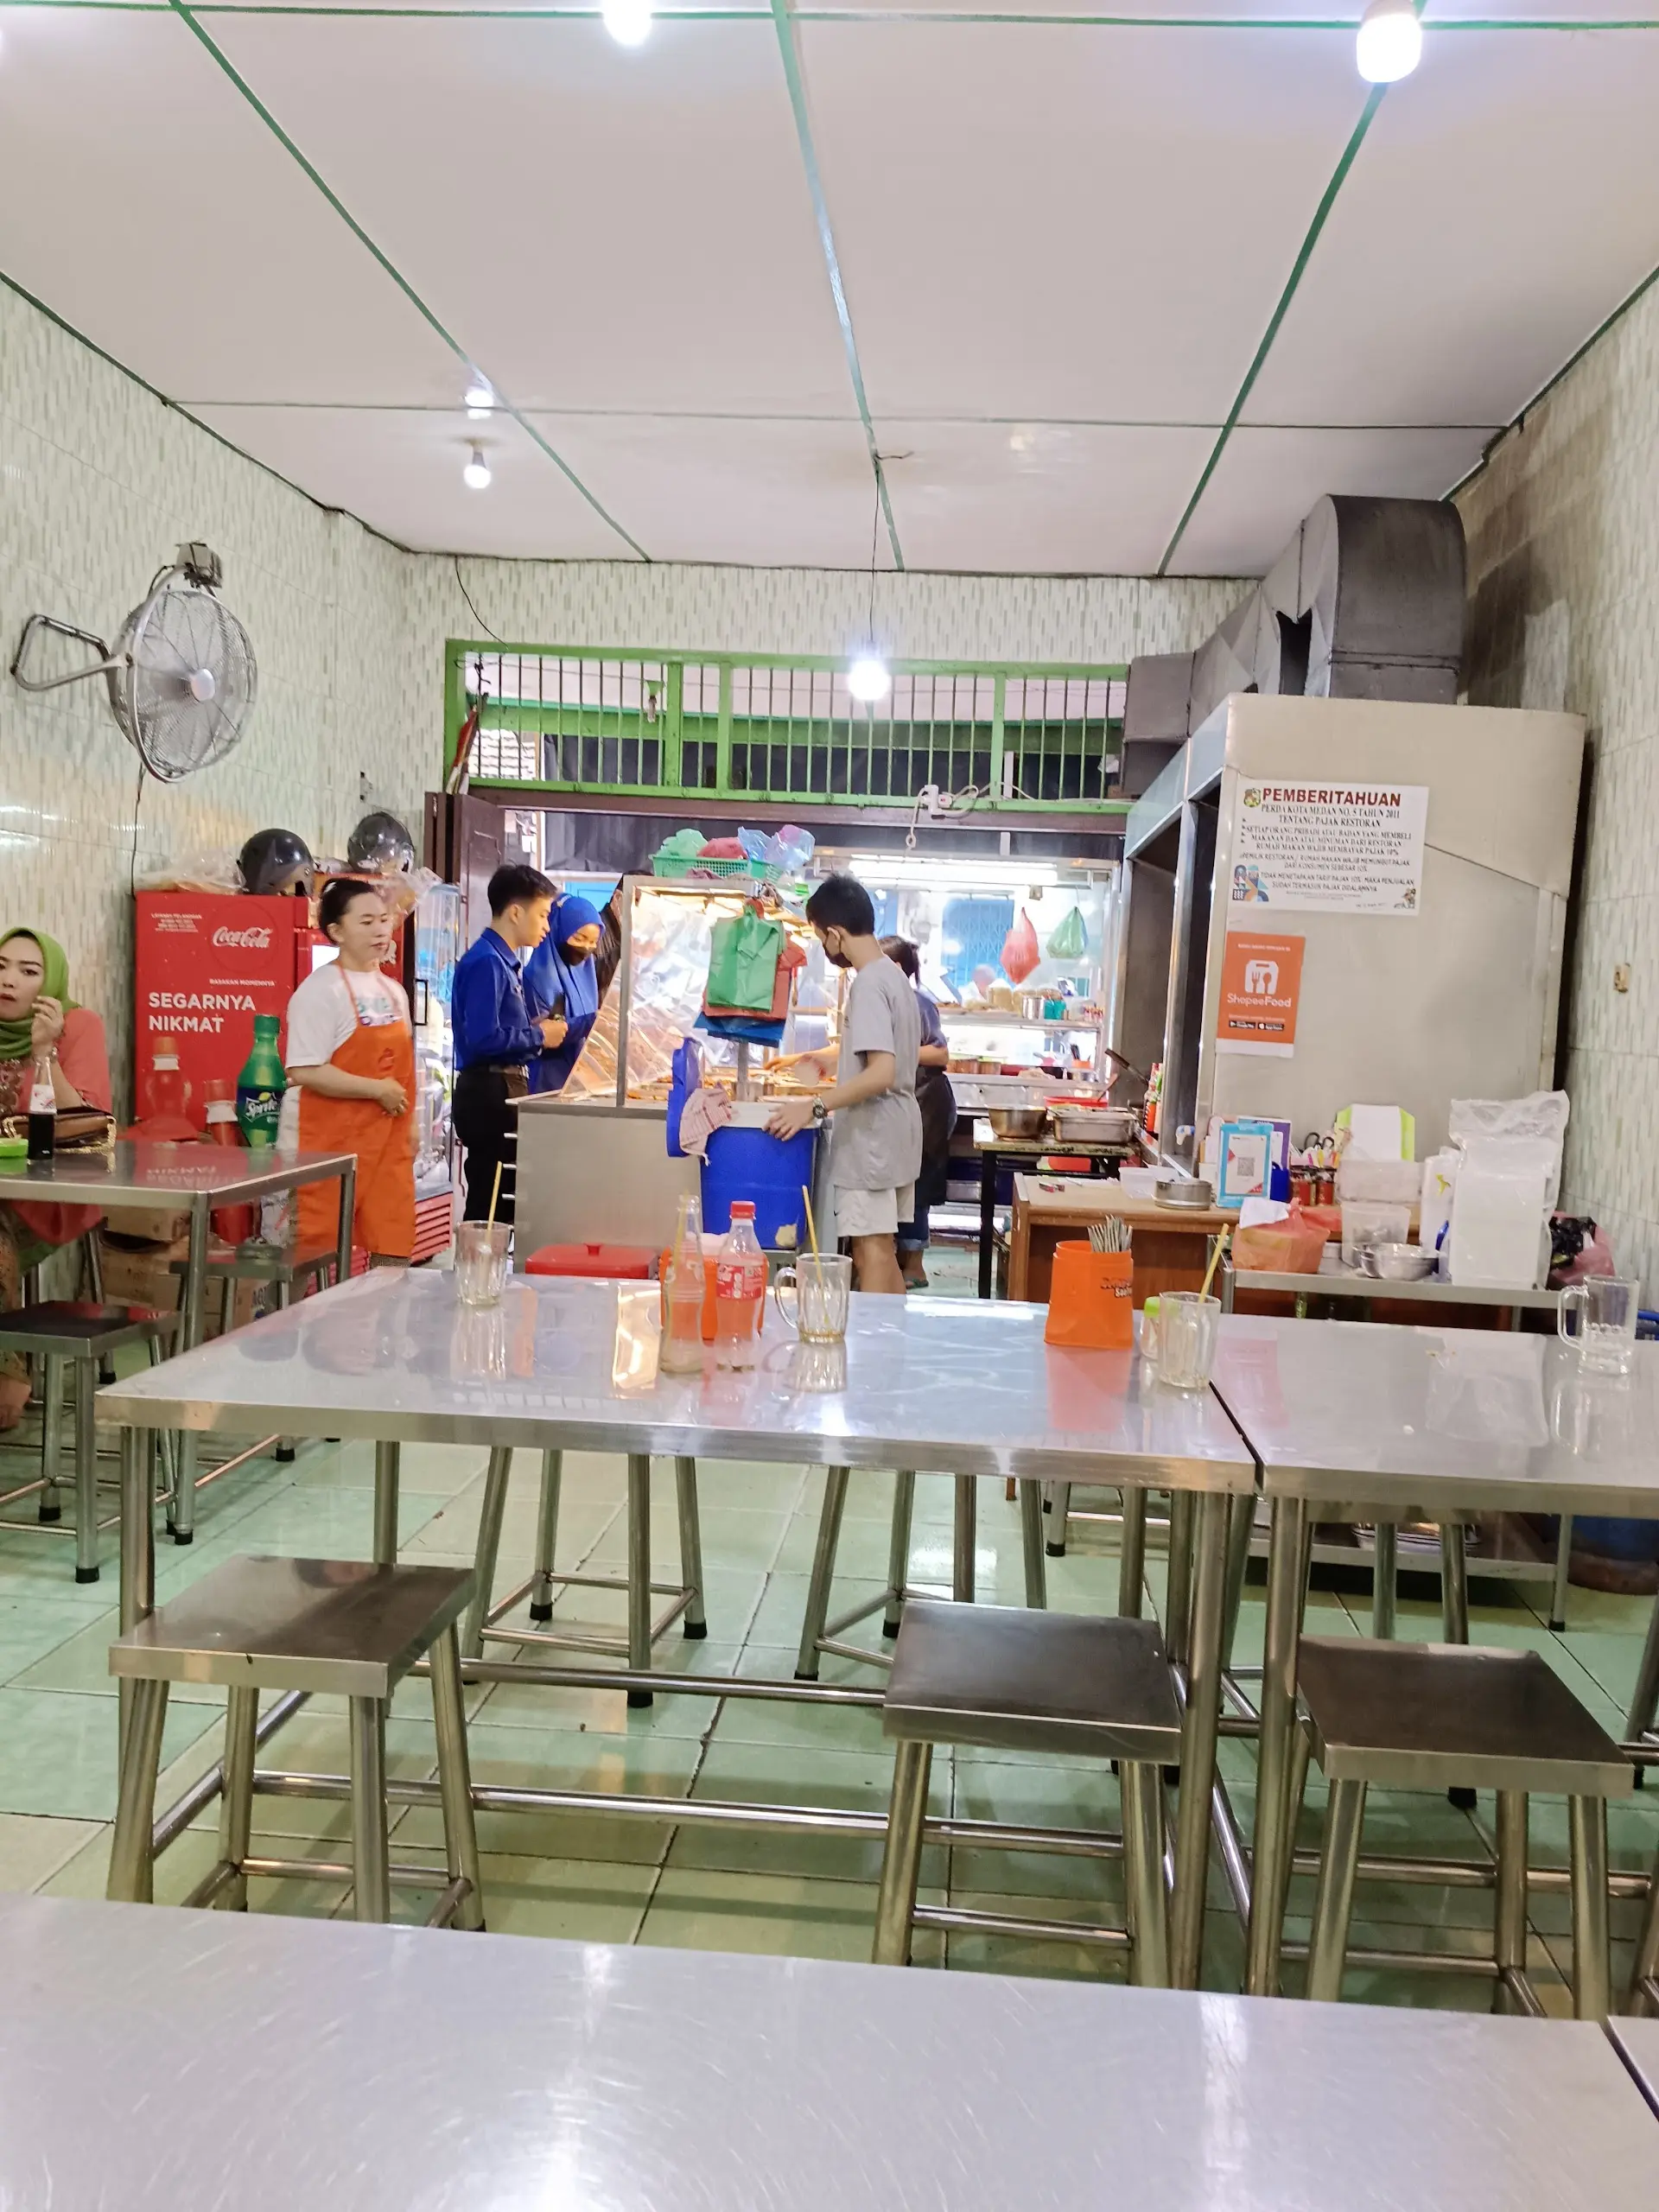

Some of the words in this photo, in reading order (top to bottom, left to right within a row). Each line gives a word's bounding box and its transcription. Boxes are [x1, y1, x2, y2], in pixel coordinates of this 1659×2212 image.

[1262, 788, 1401, 806] PEMBERITAHUAN
[1262, 804, 1286, 812] PERDA
[1287, 805, 1307, 814] KOTA
[1310, 805, 1336, 815] MEDAN
[1359, 809, 1383, 817] TAHUN
[1386, 810, 1400, 818] 2011
[1279, 815, 1313, 823] TENTANG
[1315, 817, 1338, 825] PAJAK
[1340, 817, 1381, 827] RESTORAN
[1381, 831, 1412, 840] MEMBELI
[1365, 847, 1384, 855] PAJAK
[149, 992, 256, 1011] SEGARNYA
[1227, 993, 1291, 1007] ShopeeFood
[149, 1015, 225, 1033] NIKMAT
[245, 1098, 277, 1118] Sprite
